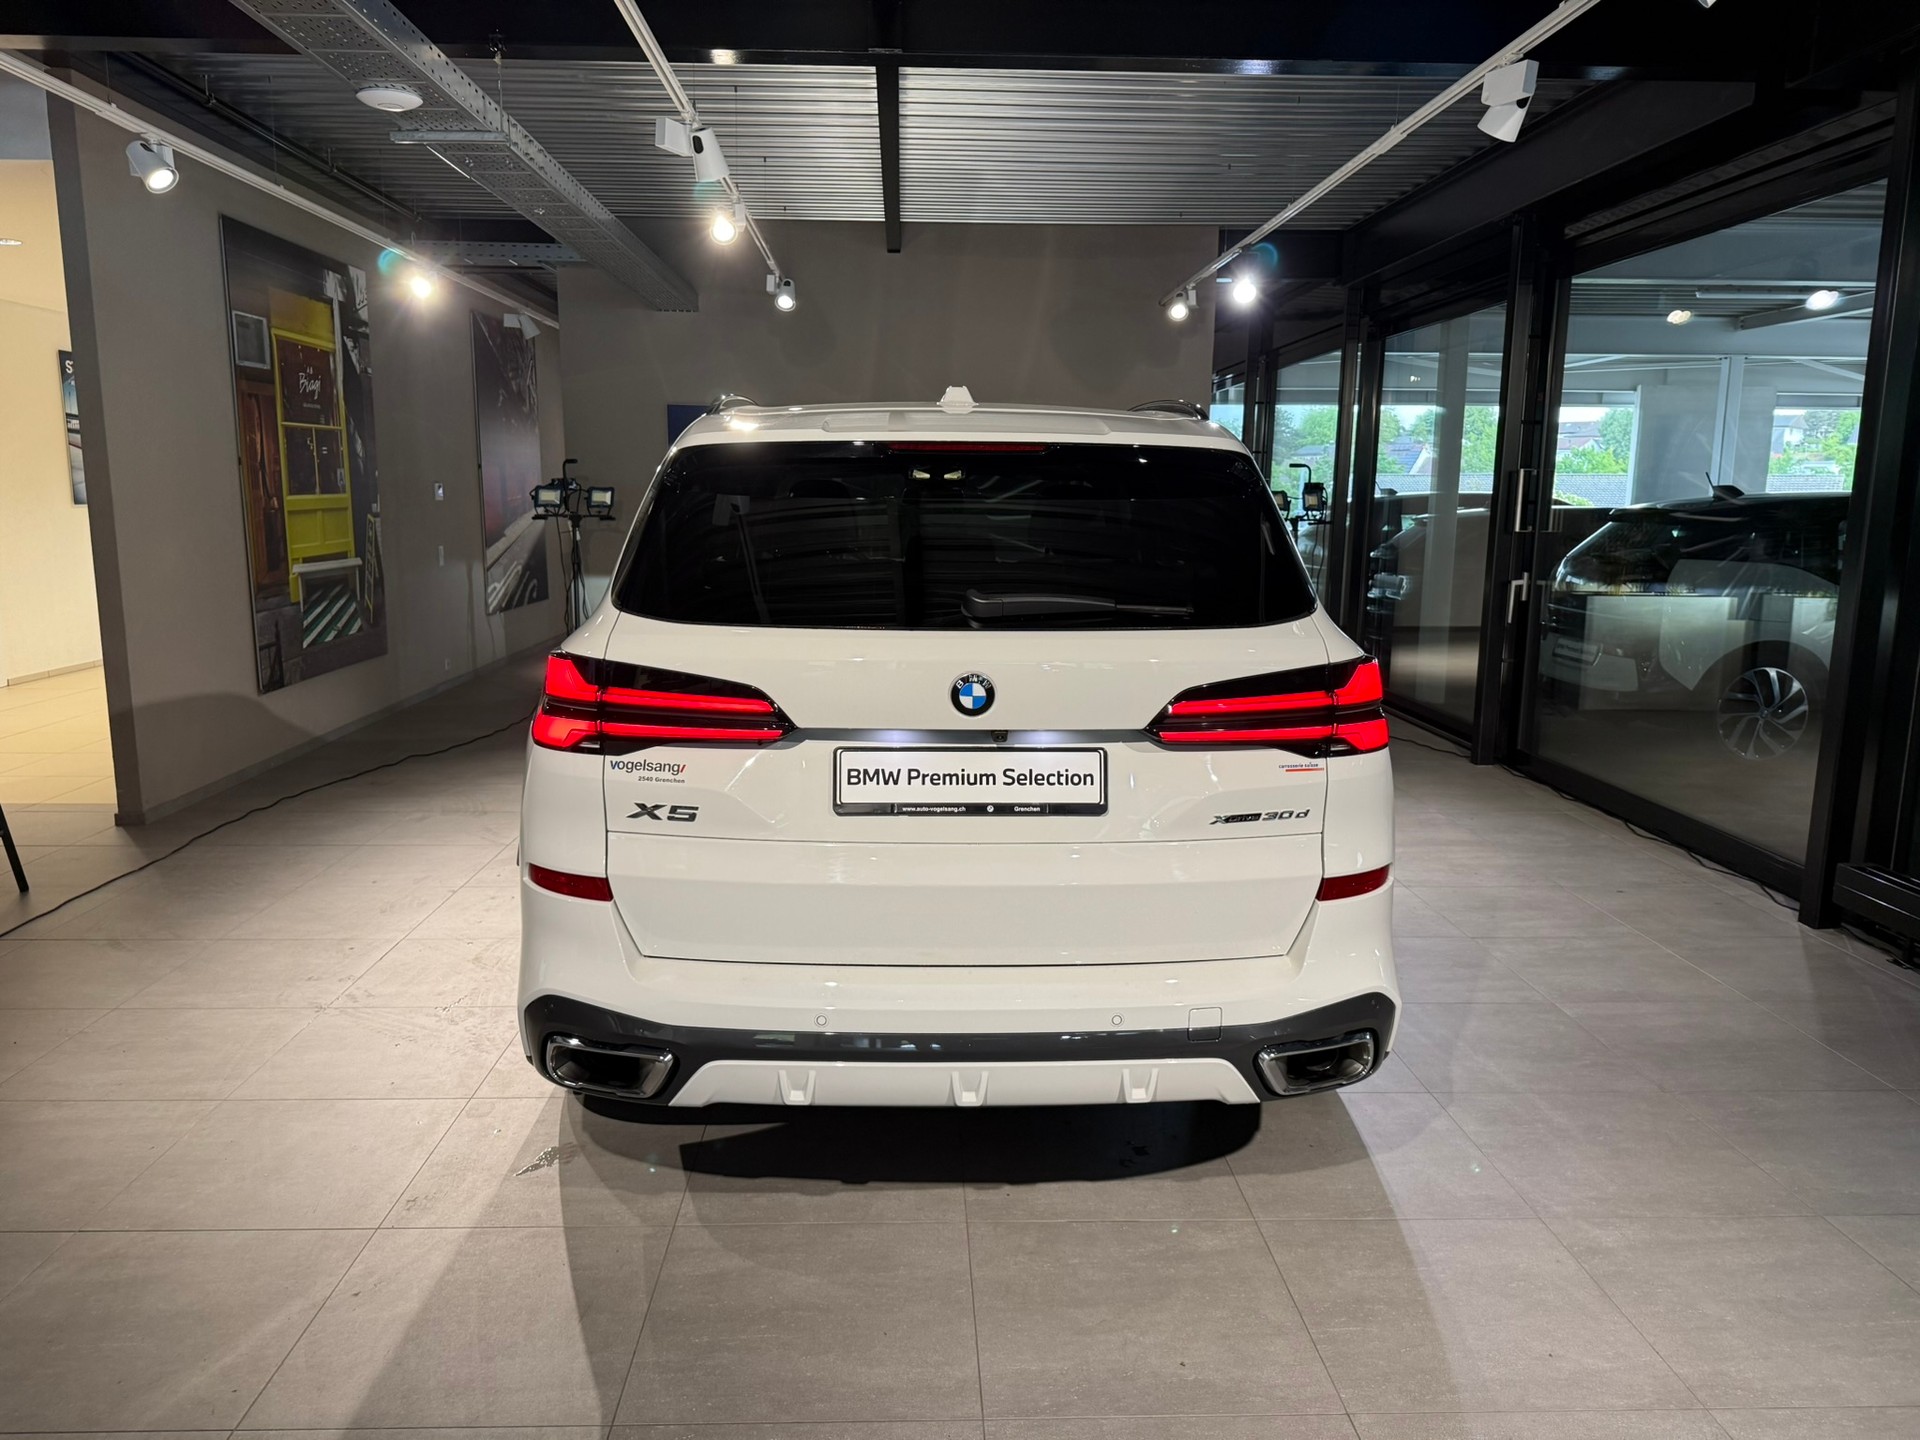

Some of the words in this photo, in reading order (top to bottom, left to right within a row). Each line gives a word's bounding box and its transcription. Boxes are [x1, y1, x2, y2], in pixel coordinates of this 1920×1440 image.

[956, 675, 991, 689] BMW
[654, 776, 685, 784] Grenchen
[847, 768, 901, 786] BMW
[907, 768, 996, 786] Premium
[1002, 768, 1094, 786] Selection
[626, 802, 699, 822] X5
